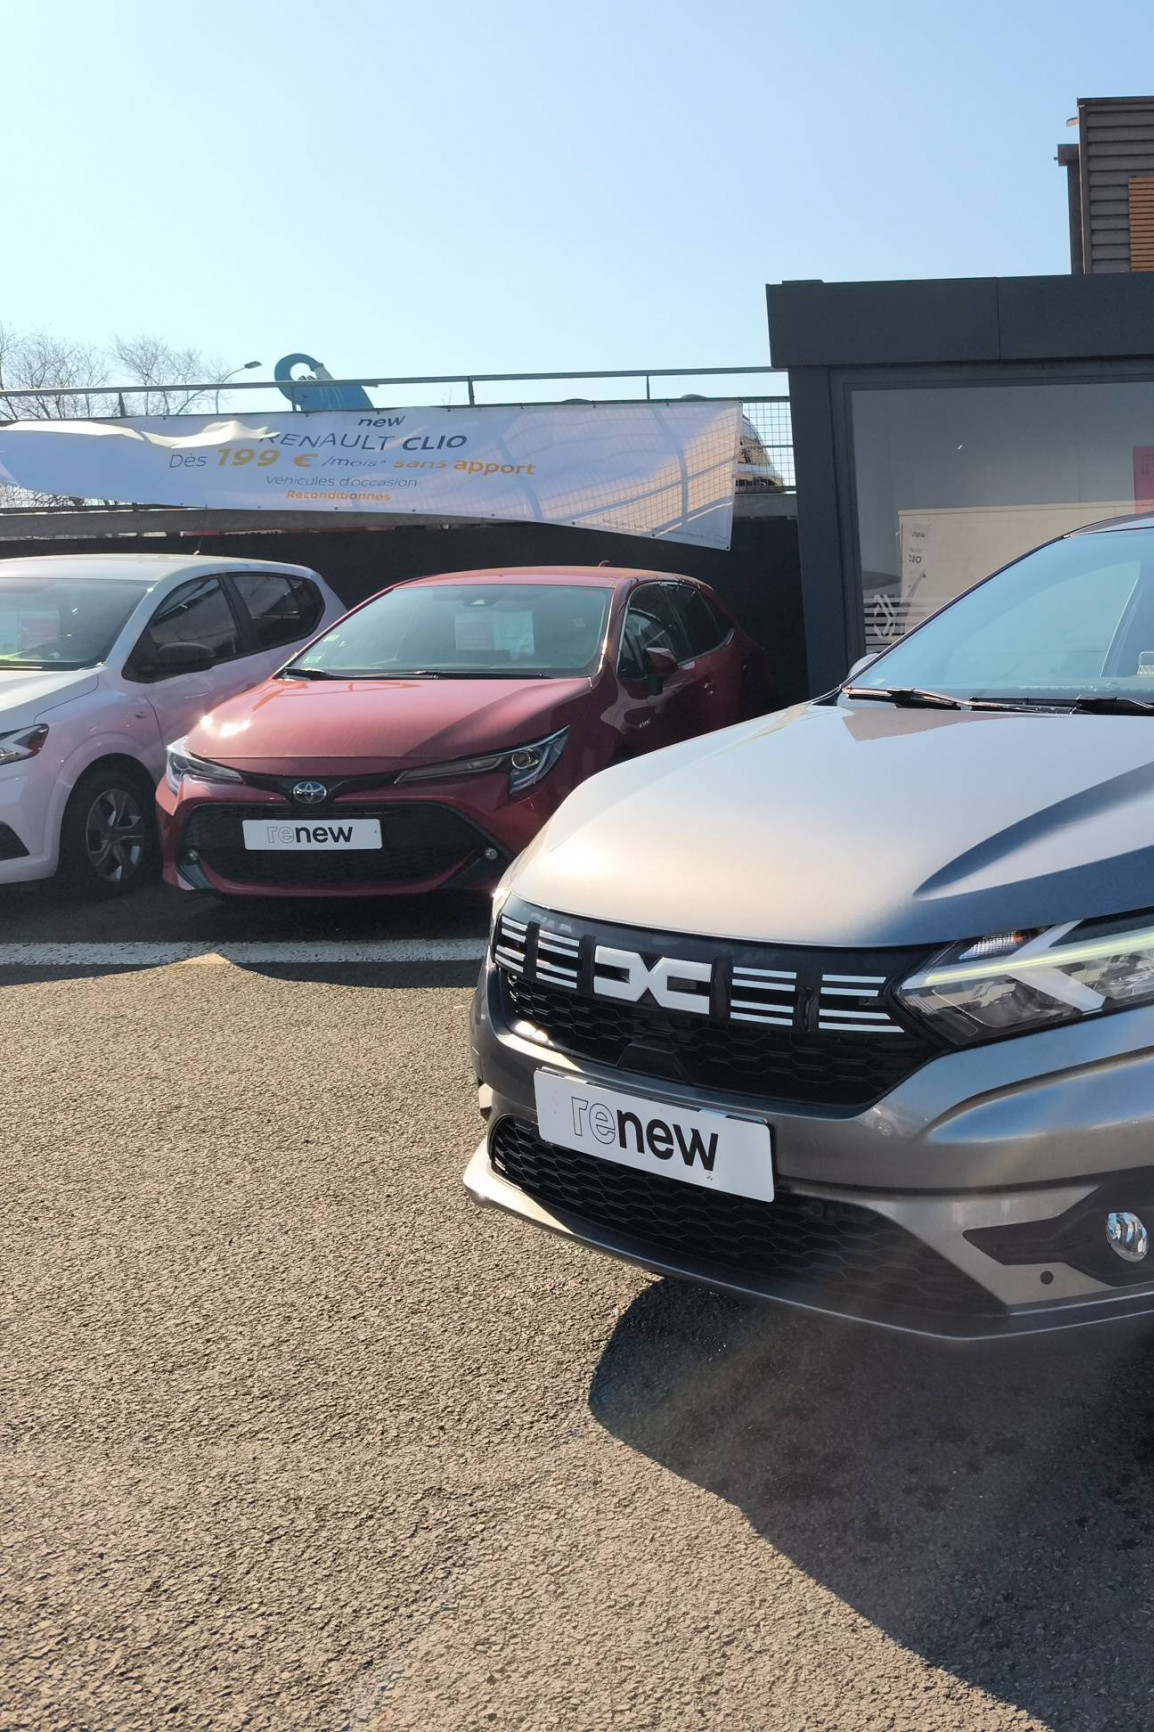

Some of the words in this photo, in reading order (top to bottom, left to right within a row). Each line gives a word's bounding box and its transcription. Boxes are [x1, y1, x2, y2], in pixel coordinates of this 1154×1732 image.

[357, 415, 406, 428] new
[402, 435, 468, 451] CLIO
[169, 453, 207, 468] Dès
[217, 449, 281, 467] 199
[292, 453, 319, 468] €
[393, 459, 447, 469] sans
[453, 459, 536, 476] apport
[266, 825, 354, 844] renew
[570, 1096, 719, 1172] renew
